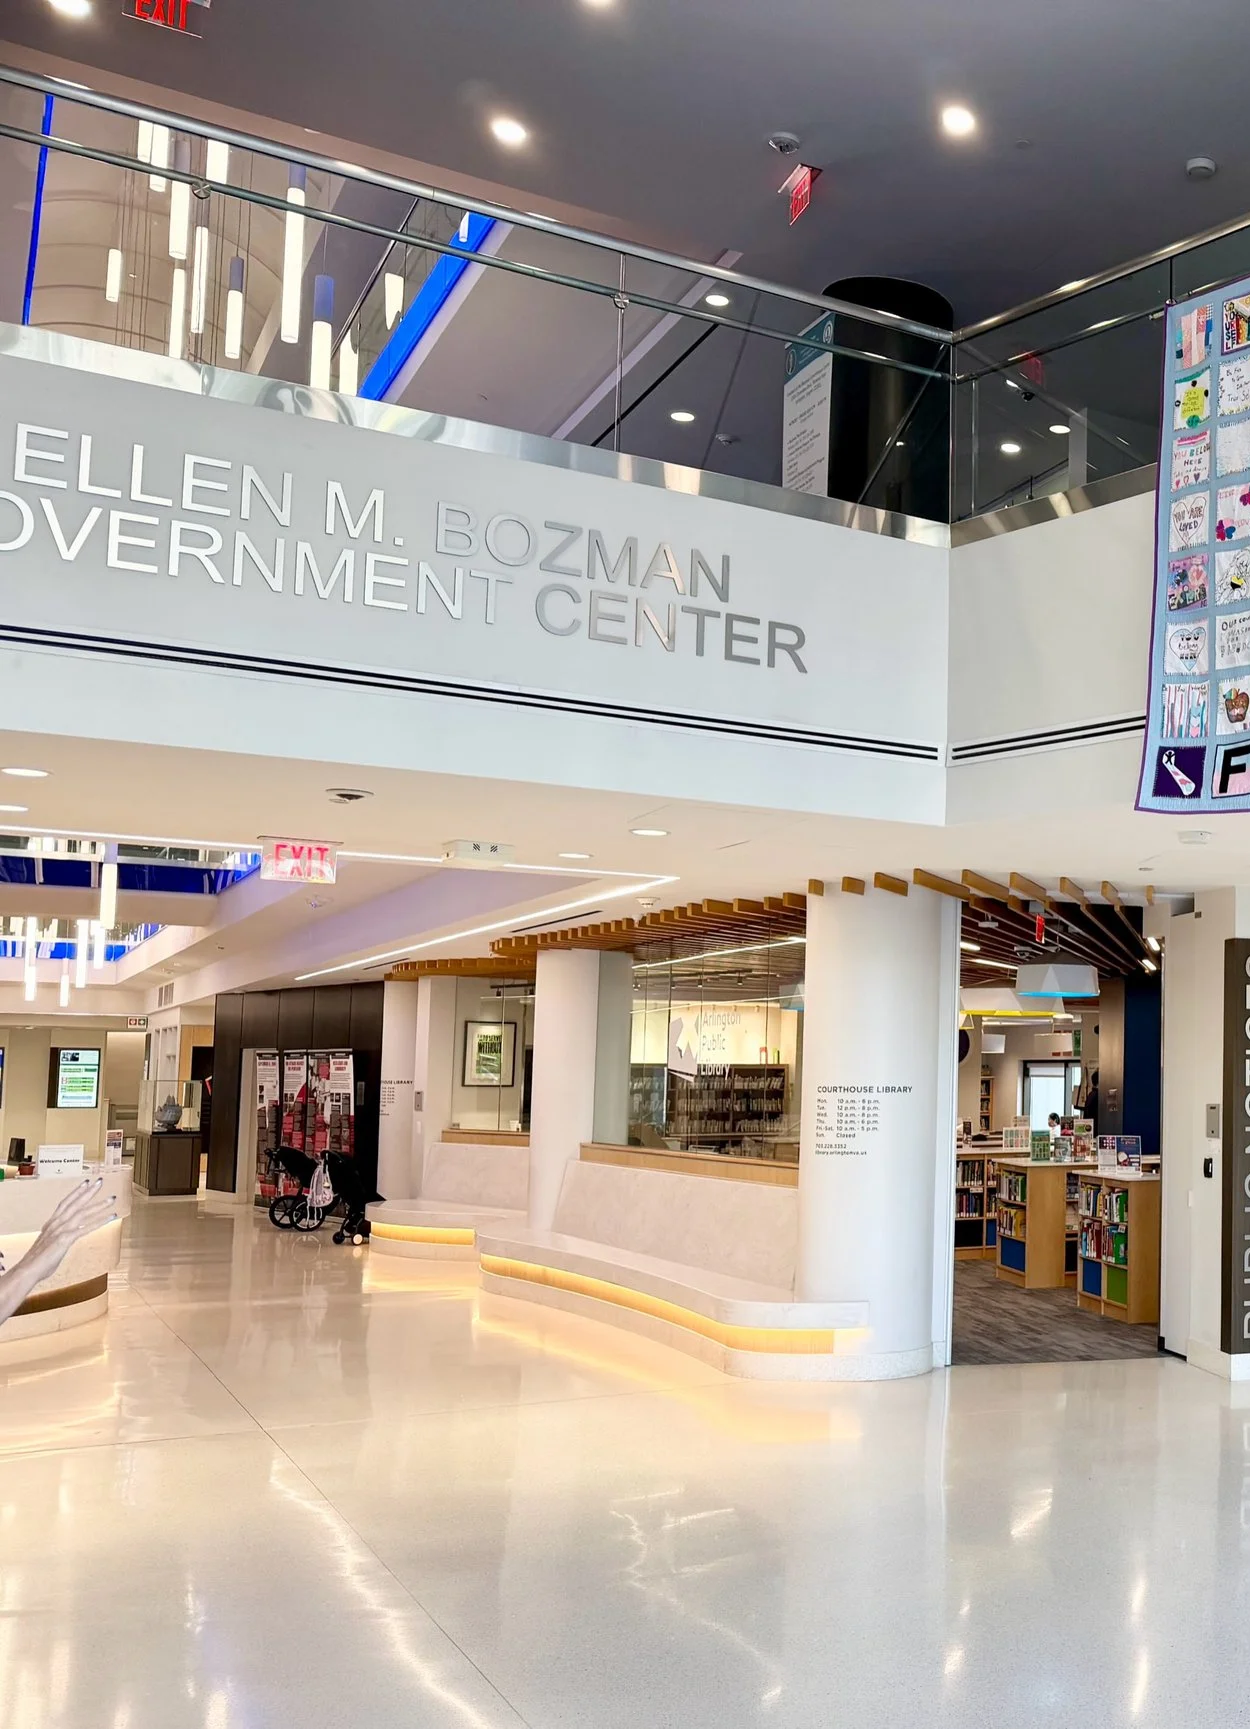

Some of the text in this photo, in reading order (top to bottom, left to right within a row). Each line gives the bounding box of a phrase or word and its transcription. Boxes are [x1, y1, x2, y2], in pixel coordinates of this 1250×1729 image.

[14, 423, 731, 603] ELLEN M. BOZMAN
[1173, 506, 1203, 523] YOU ARE
[1179, 520, 1198, 533] LOVED
[0, 490, 809, 674] OVERNMENT CENTER
[275, 844, 329, 877] EXIT
[703, 1011, 741, 1031] Arlington
[702, 1034, 726, 1051] Public
[700, 1058, 731, 1080] Library
